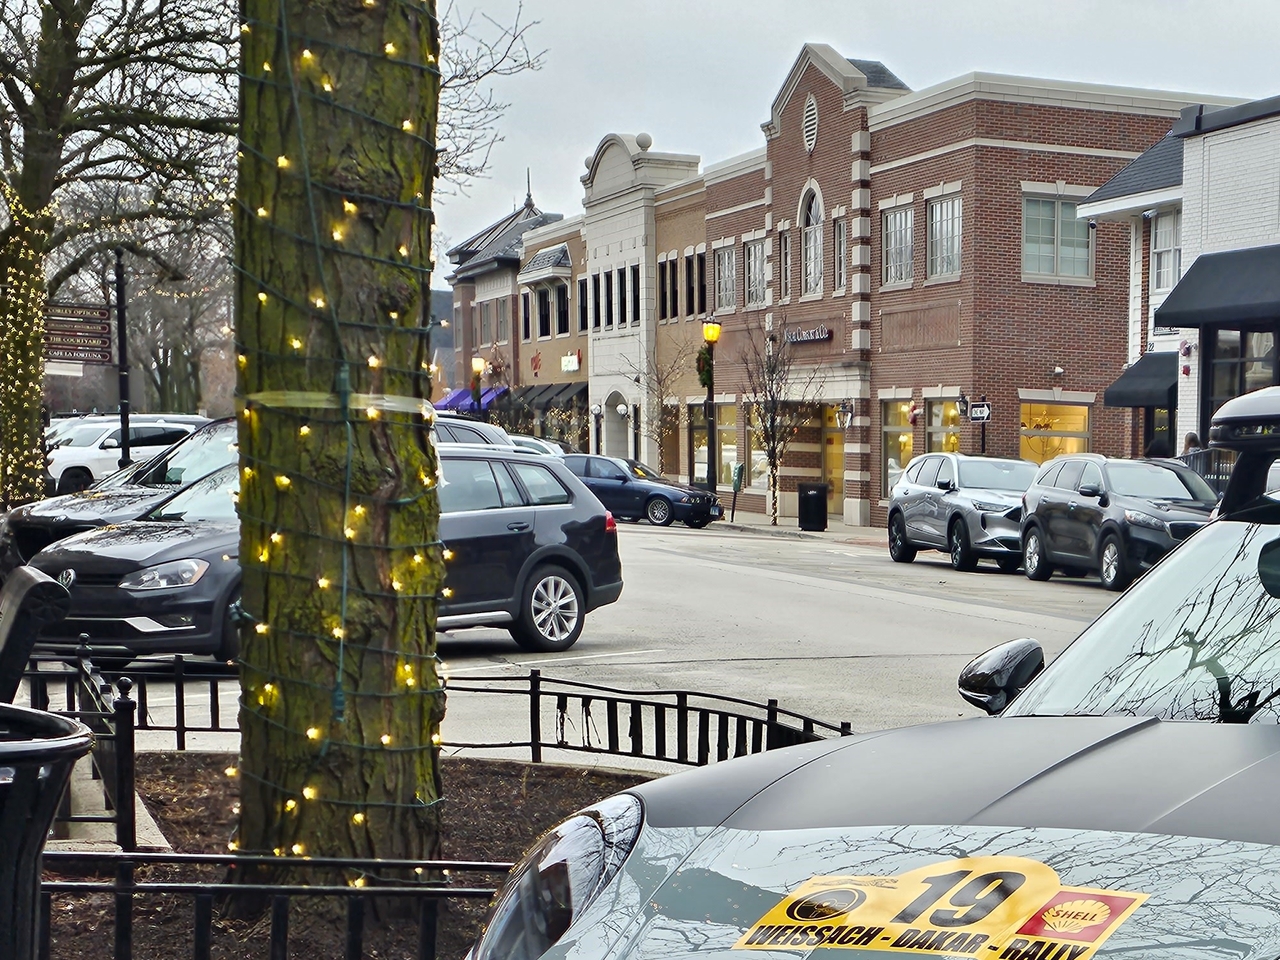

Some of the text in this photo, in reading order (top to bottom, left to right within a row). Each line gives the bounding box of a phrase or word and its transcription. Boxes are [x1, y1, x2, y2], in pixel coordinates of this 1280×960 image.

[889, 869, 1026, 928] 19
[1052, 909, 1098, 922] SHELL
[744, 924, 882, 947] WEISSACH
[889, 927, 990, 954] DAKAR
